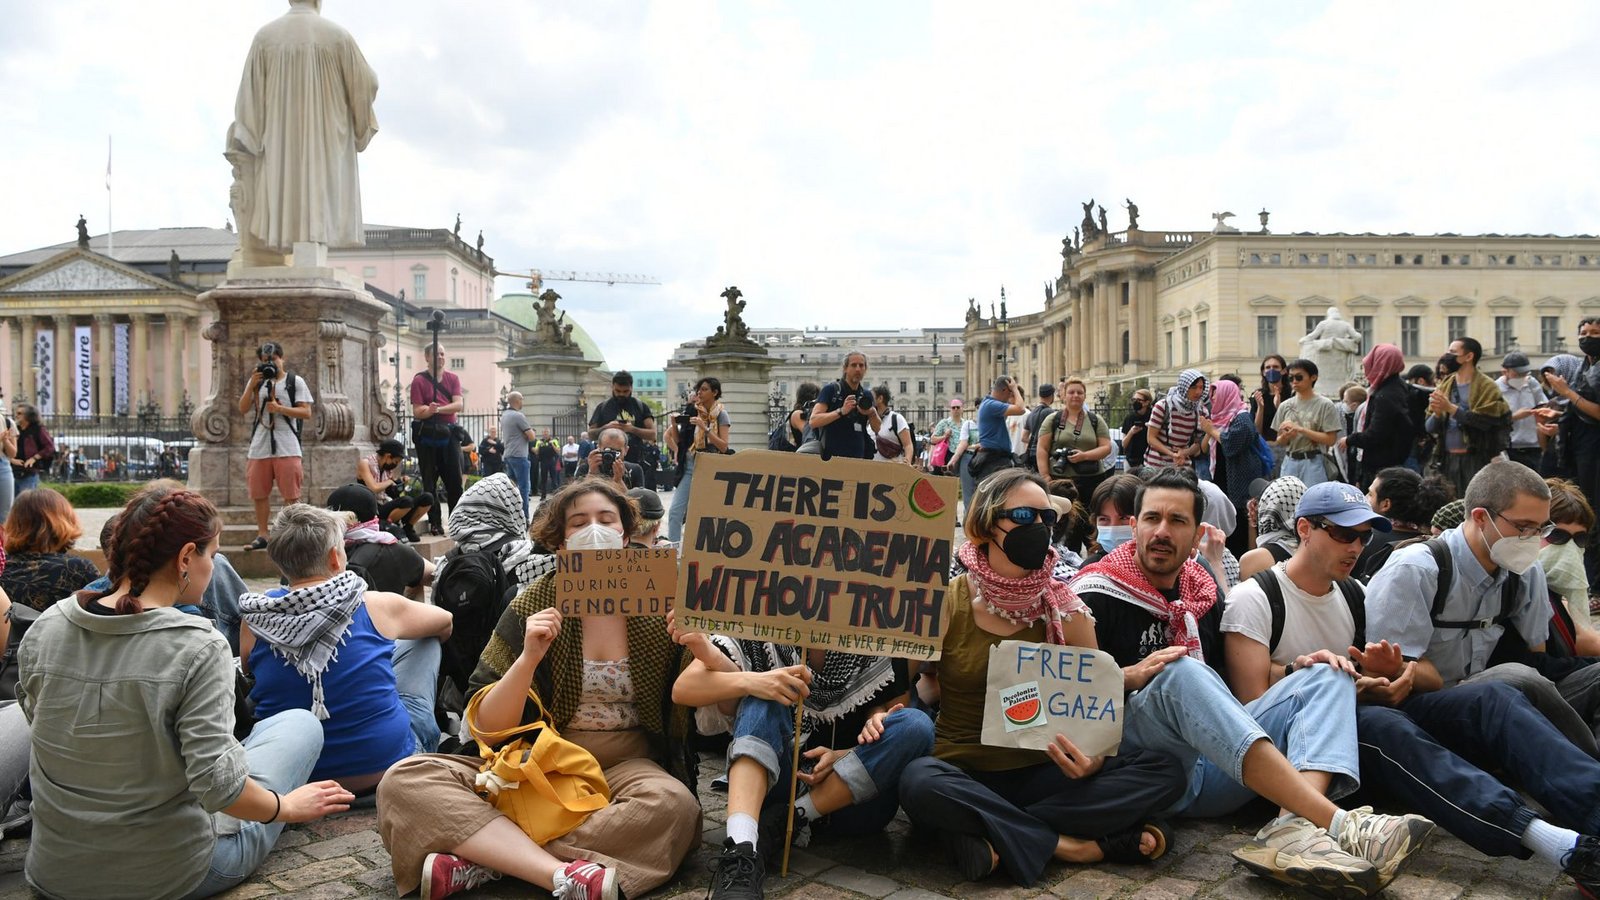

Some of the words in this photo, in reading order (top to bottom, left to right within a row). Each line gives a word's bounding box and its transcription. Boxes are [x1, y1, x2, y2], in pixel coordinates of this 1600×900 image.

[78, 335, 90, 411] Overture
[714, 471, 844, 519] THERE
[853, 481, 897, 522] IS
[558, 552, 583, 574] NO
[595, 550, 670, 561] BUSINESS
[694, 516, 754, 559] NO
[760, 518, 950, 587] ACADEMIA
[563, 578, 628, 593] DURING
[645, 578, 656, 591] A
[607, 565, 651, 574] USUAL
[561, 596, 676, 615] GENOCIDE
[684, 561, 842, 622] WITHOUT
[845, 581, 945, 638] TRUTH
[684, 615, 744, 634] STUDENTS
[753, 622, 801, 643] UNITED
[809, 630, 831, 645] WILL
[837, 633, 873, 651] NEVER
[876, 637, 888, 652] BE
[890, 639, 936, 660] DEFEATED
[1017, 646, 1096, 683] FREE
[1002, 686, 1037, 704] Decolonize
[1009, 692, 1039, 707] Palestine
[1048, 691, 1116, 723] GAZA
